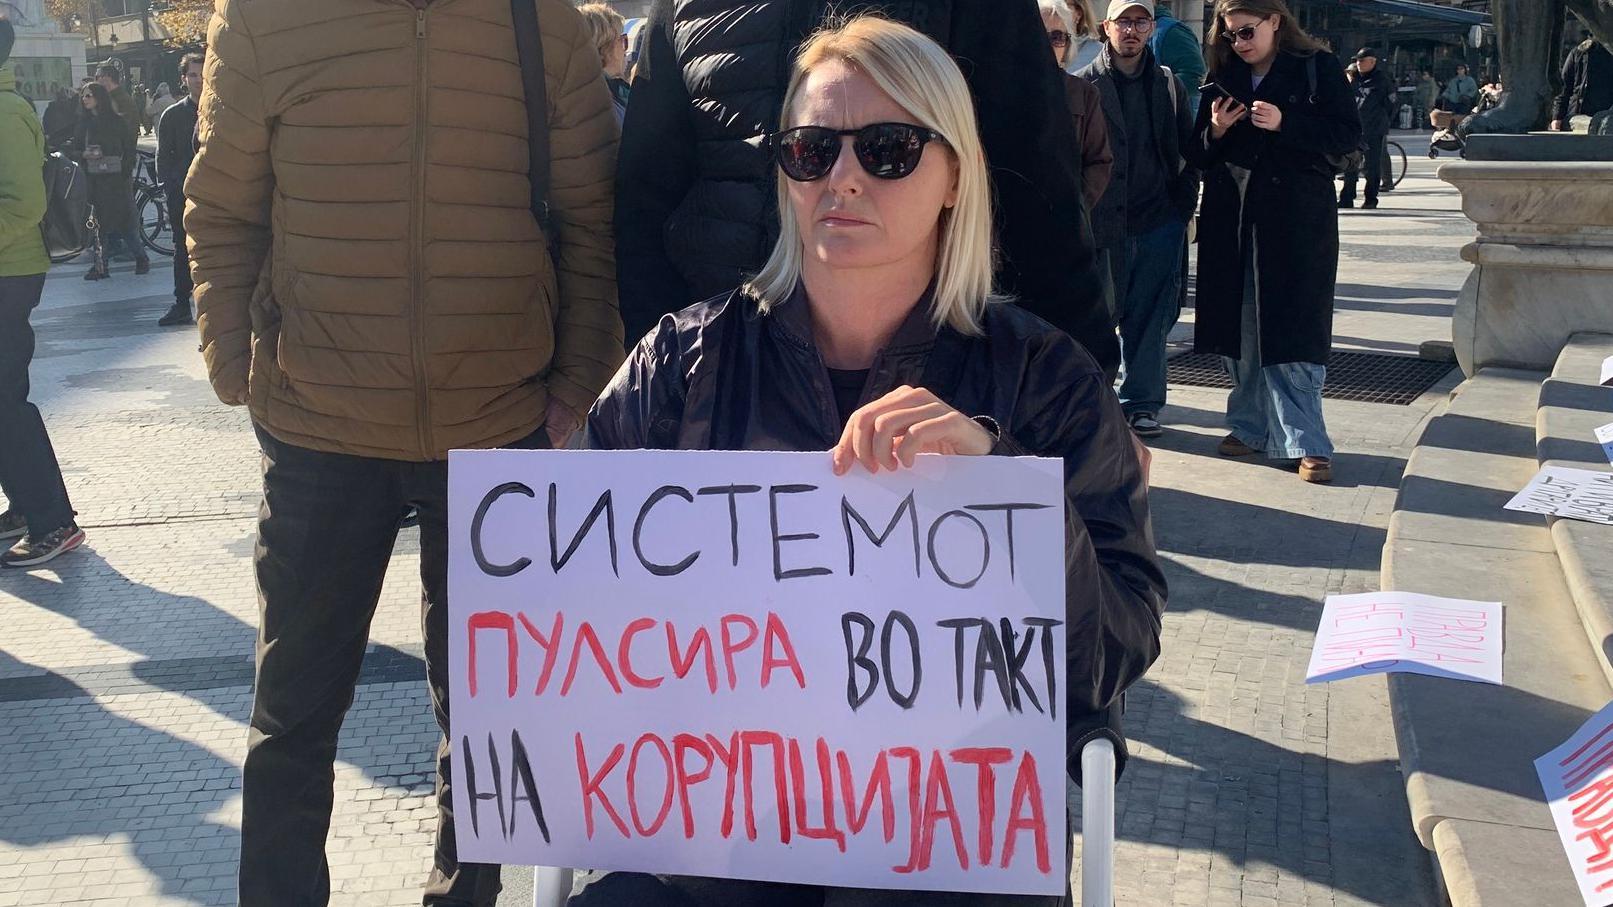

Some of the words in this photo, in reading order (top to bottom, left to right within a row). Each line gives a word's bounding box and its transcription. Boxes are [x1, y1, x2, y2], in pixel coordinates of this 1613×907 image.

[470, 482, 1055, 588] СИСТЕМОТ
[467, 611, 806, 698] ПУЛСИРА
[841, 610, 922, 712] ВО
[936, 616, 1064, 721] ТАКТ
[1335, 602, 1405, 628] НЕ
[1407, 603, 1488, 664] ПРАВДА
[463, 728, 550, 844] НА
[575, 730, 1052, 874] КОРУПЦИЈАТА
